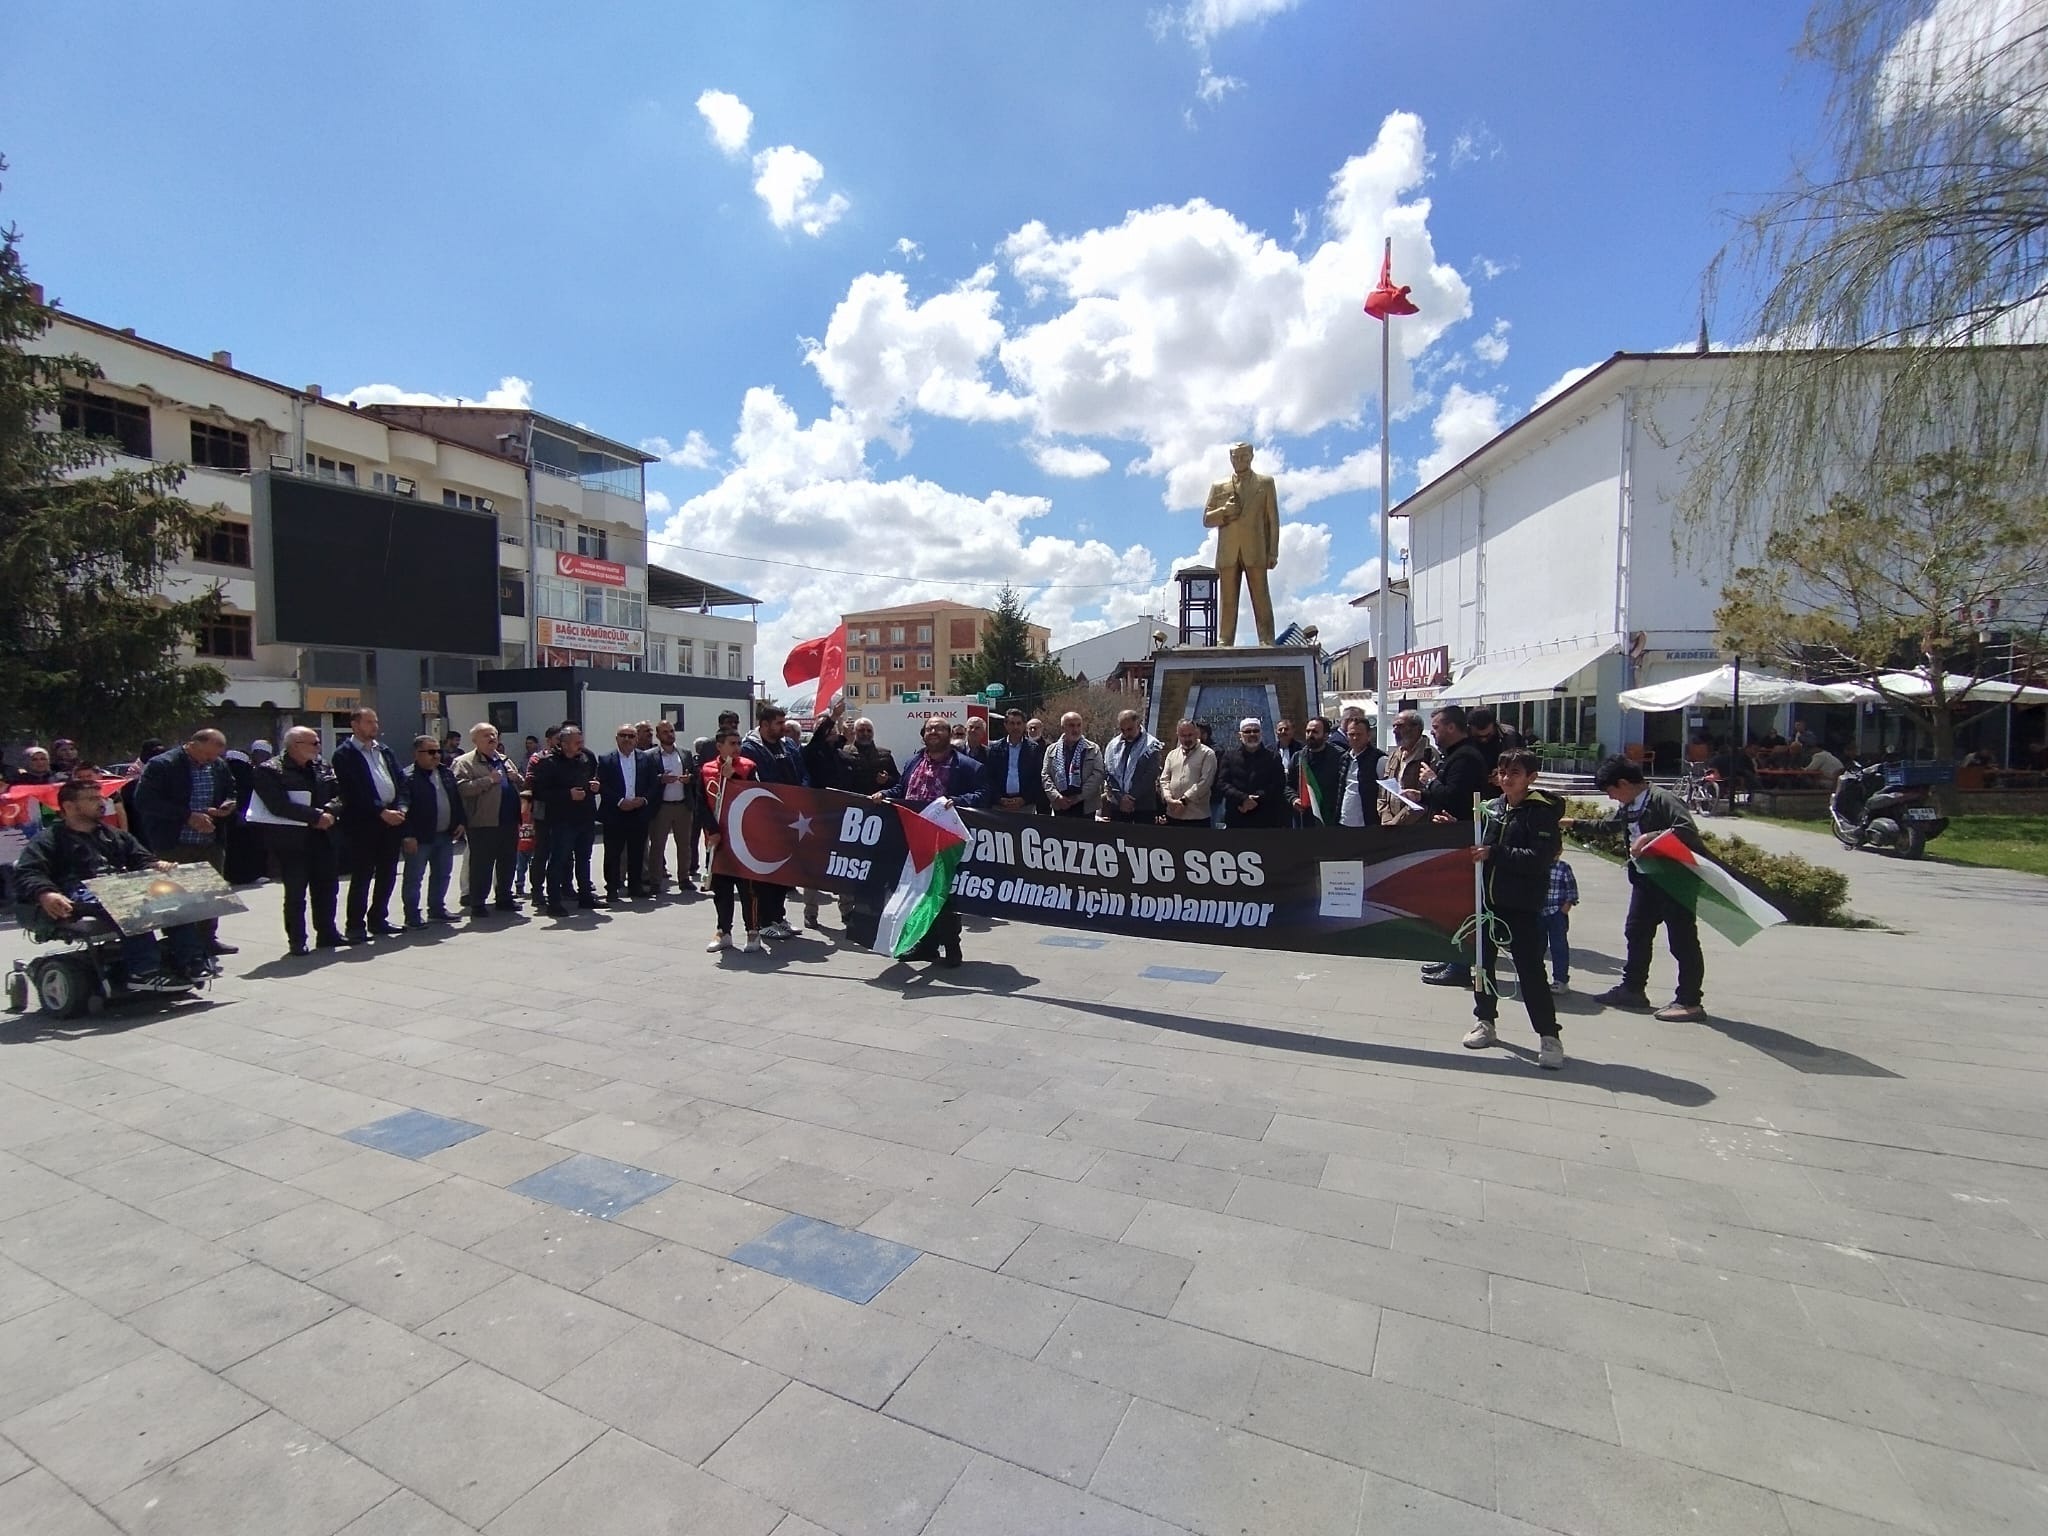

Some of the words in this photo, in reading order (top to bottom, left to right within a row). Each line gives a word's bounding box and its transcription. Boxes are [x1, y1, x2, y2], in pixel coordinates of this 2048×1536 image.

[555, 623, 580, 636] BAĞCI
[581, 626, 630, 641] KÖMÜRCÜLÜK
[907, 711, 957, 719] AKBANK
[1021, 827, 1176, 885] Gazze'ye
[1183, 849, 1265, 887] ses
[997, 877, 1073, 911] olmak
[1076, 885, 1126, 919] için
[1129, 892, 1275, 928] toplanıyor
